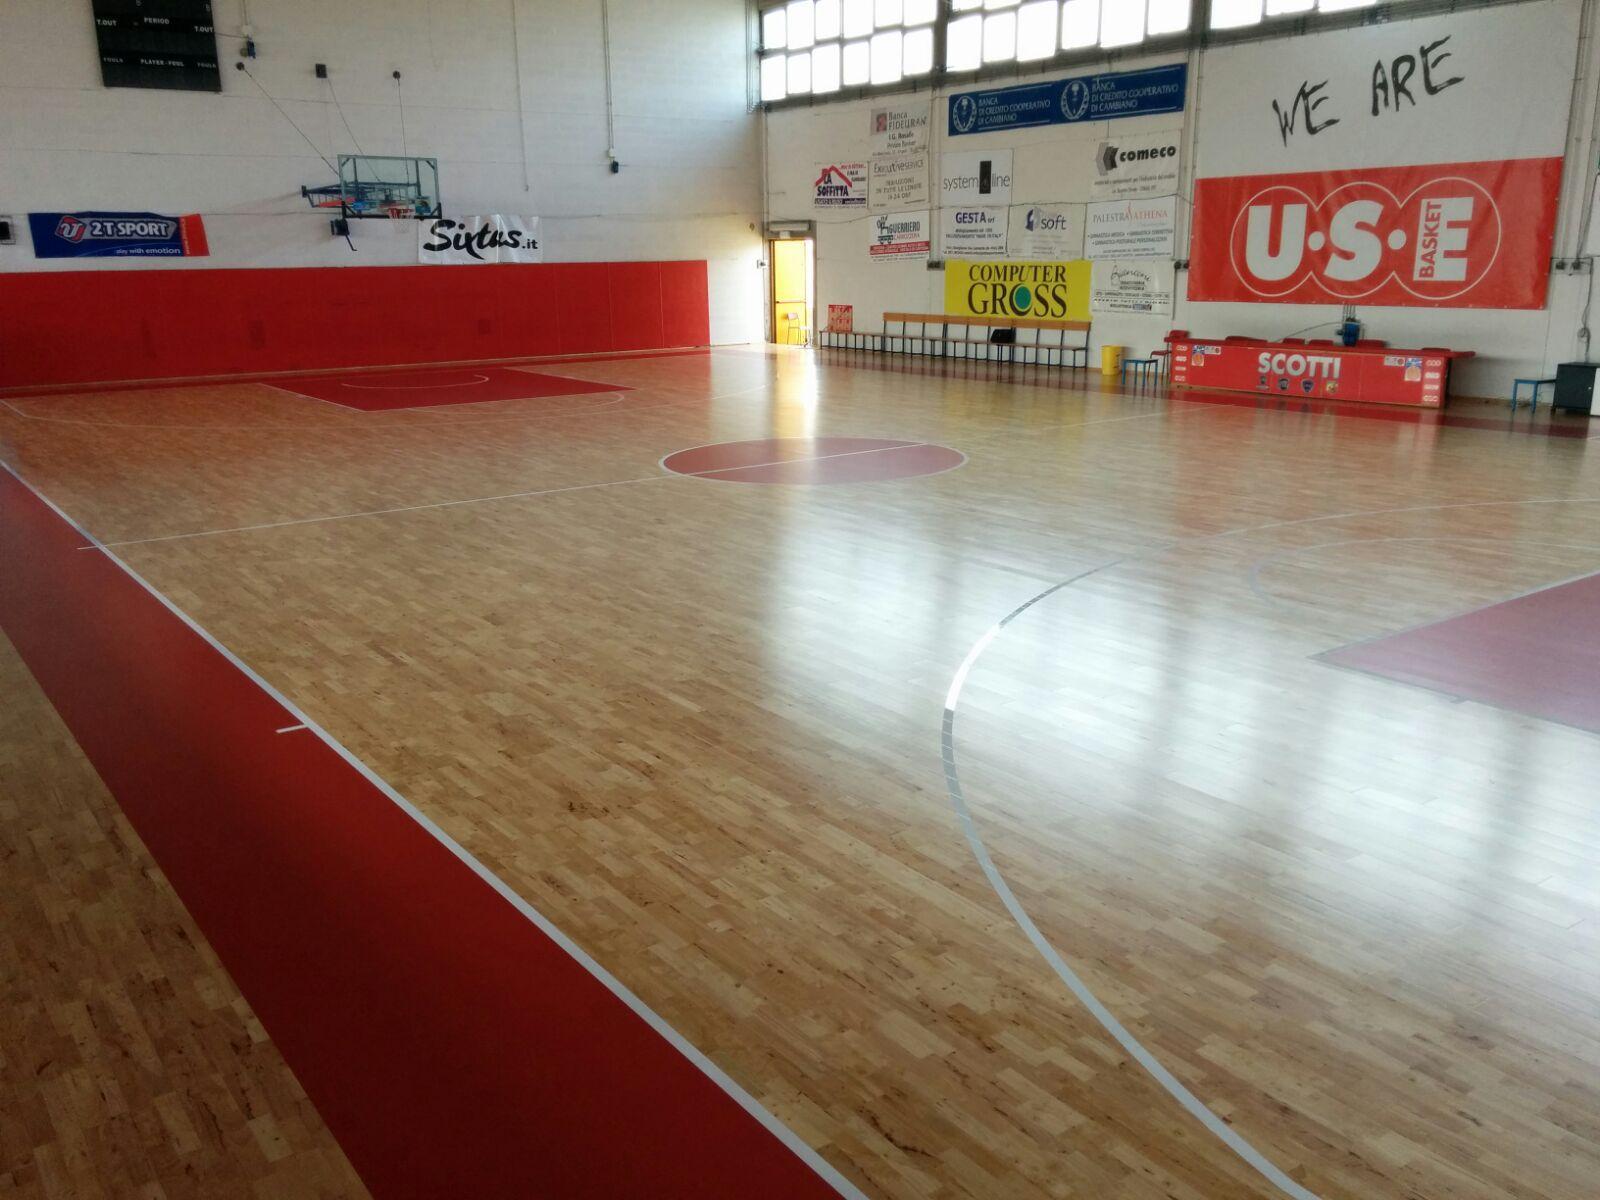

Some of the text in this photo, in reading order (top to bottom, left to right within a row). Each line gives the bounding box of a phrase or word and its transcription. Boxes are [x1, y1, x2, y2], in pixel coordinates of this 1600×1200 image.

[144, 17, 170, 25] PERIOD
[1091, 80, 1117, 93] BANCA
[1100, 89, 1128, 101] CREDITO
[1128, 83, 1179, 98] COOPERATIVO
[1272, 35, 1465, 147] WE ARE
[979, 97, 999, 107] BANCA
[1010, 99, 1051, 113] COOPERATIVO
[1099, 99, 1138, 112] CAMBIANO
[888, 112, 908, 120] Banca
[1120, 146, 1177, 162] comeco
[823, 172, 833, 184] LA
[943, 173, 1010, 191] system line
[817, 185, 849, 197] SOFFITTA
[955, 212, 986, 224] GESTA
[1041, 215, 1067, 230] soft
[1093, 209, 1168, 223] PALESTRA ATHENA
[118, 222, 168, 236] SPORT
[1419, 202, 1442, 278] BASKET
[969, 265, 1066, 282] COMPUTER
[968, 282, 1067, 318] GROSS
[1258, 352, 1341, 379] SCOTTI
